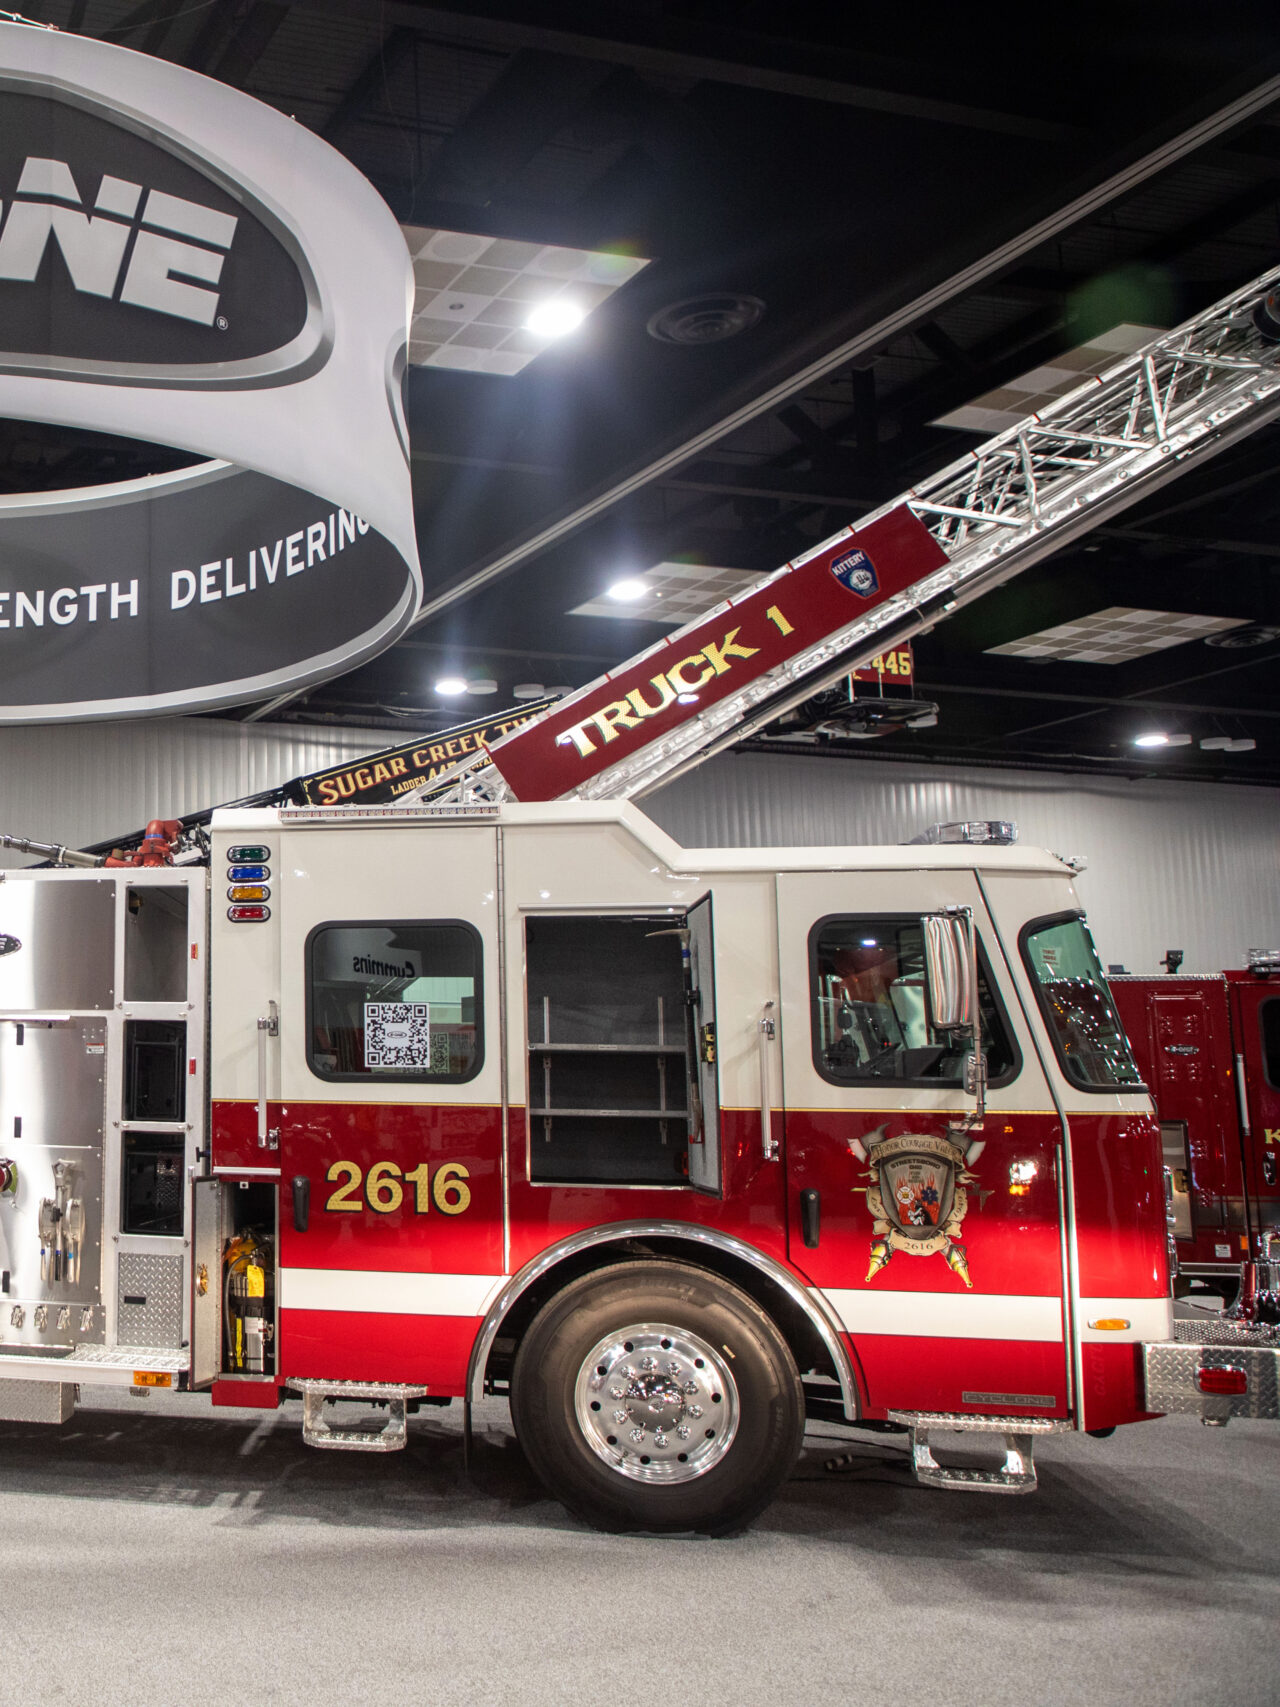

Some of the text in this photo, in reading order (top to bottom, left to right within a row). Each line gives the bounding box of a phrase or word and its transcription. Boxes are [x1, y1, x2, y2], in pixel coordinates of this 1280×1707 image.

[831, 550, 865, 576] KITTERY
[872, 651, 912, 676] 445
[555, 605, 795, 758] TRUCK 1
[317, 729, 490, 806] SUGAR CREEK
[390, 775, 427, 796] LADDER
[325, 1160, 471, 1216] 2616
[904, 1241, 934, 1251] 2616
